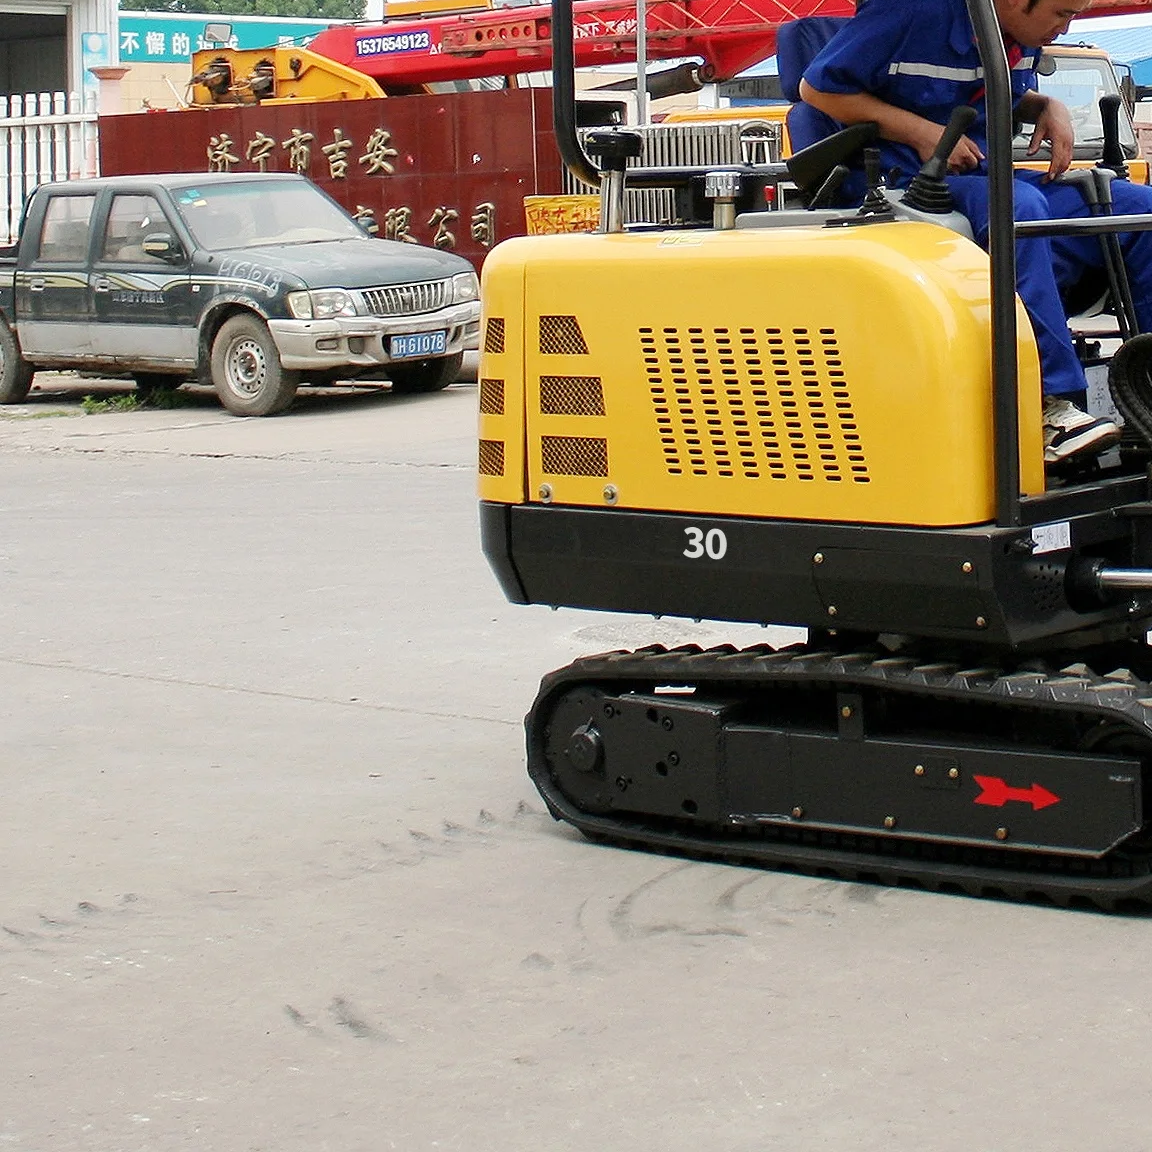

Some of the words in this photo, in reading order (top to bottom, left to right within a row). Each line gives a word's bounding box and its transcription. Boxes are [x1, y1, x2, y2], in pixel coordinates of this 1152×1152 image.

[356, 32, 429, 55] 15376549123
[207, 127, 398, 179] 济宁市吉安
[682, 526, 728, 560] 30
